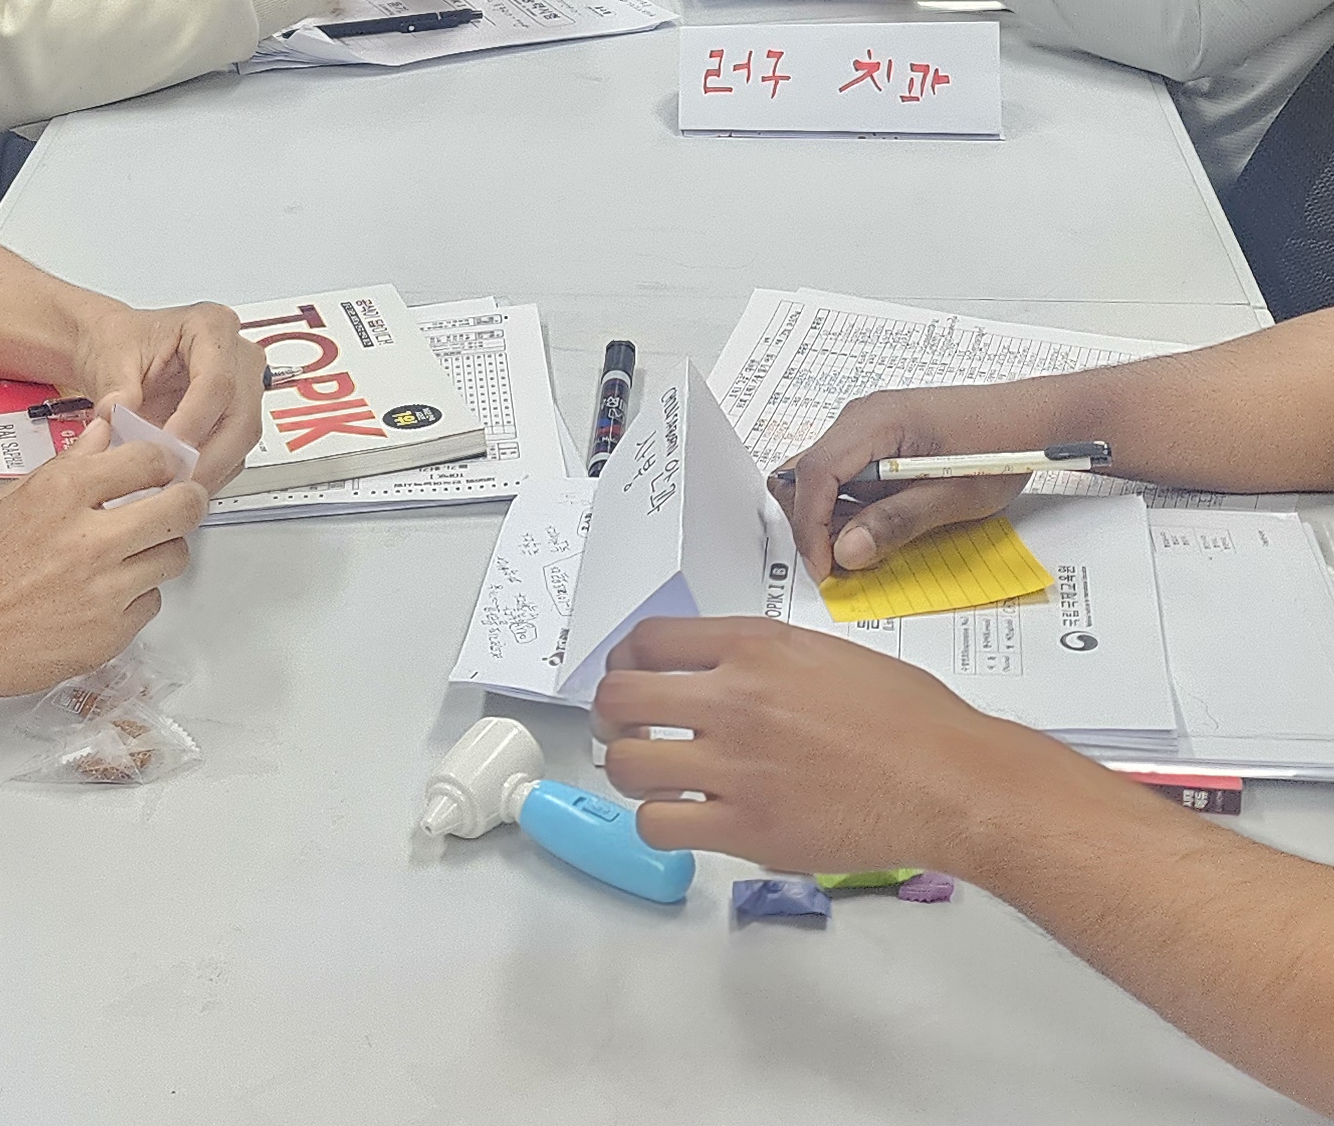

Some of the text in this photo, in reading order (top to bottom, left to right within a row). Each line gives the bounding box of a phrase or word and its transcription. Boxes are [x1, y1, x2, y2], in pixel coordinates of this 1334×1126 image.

[703, 49, 951, 103] 러구 치과
[240, 304, 388, 453] TOPIK
[1, 442, 25, 469] SAPHAL
[647, 459, 680, 516] 안과
[764, 593, 785, 618] OPIK
[1058, 565, 1080, 627] 국립국제교육원
